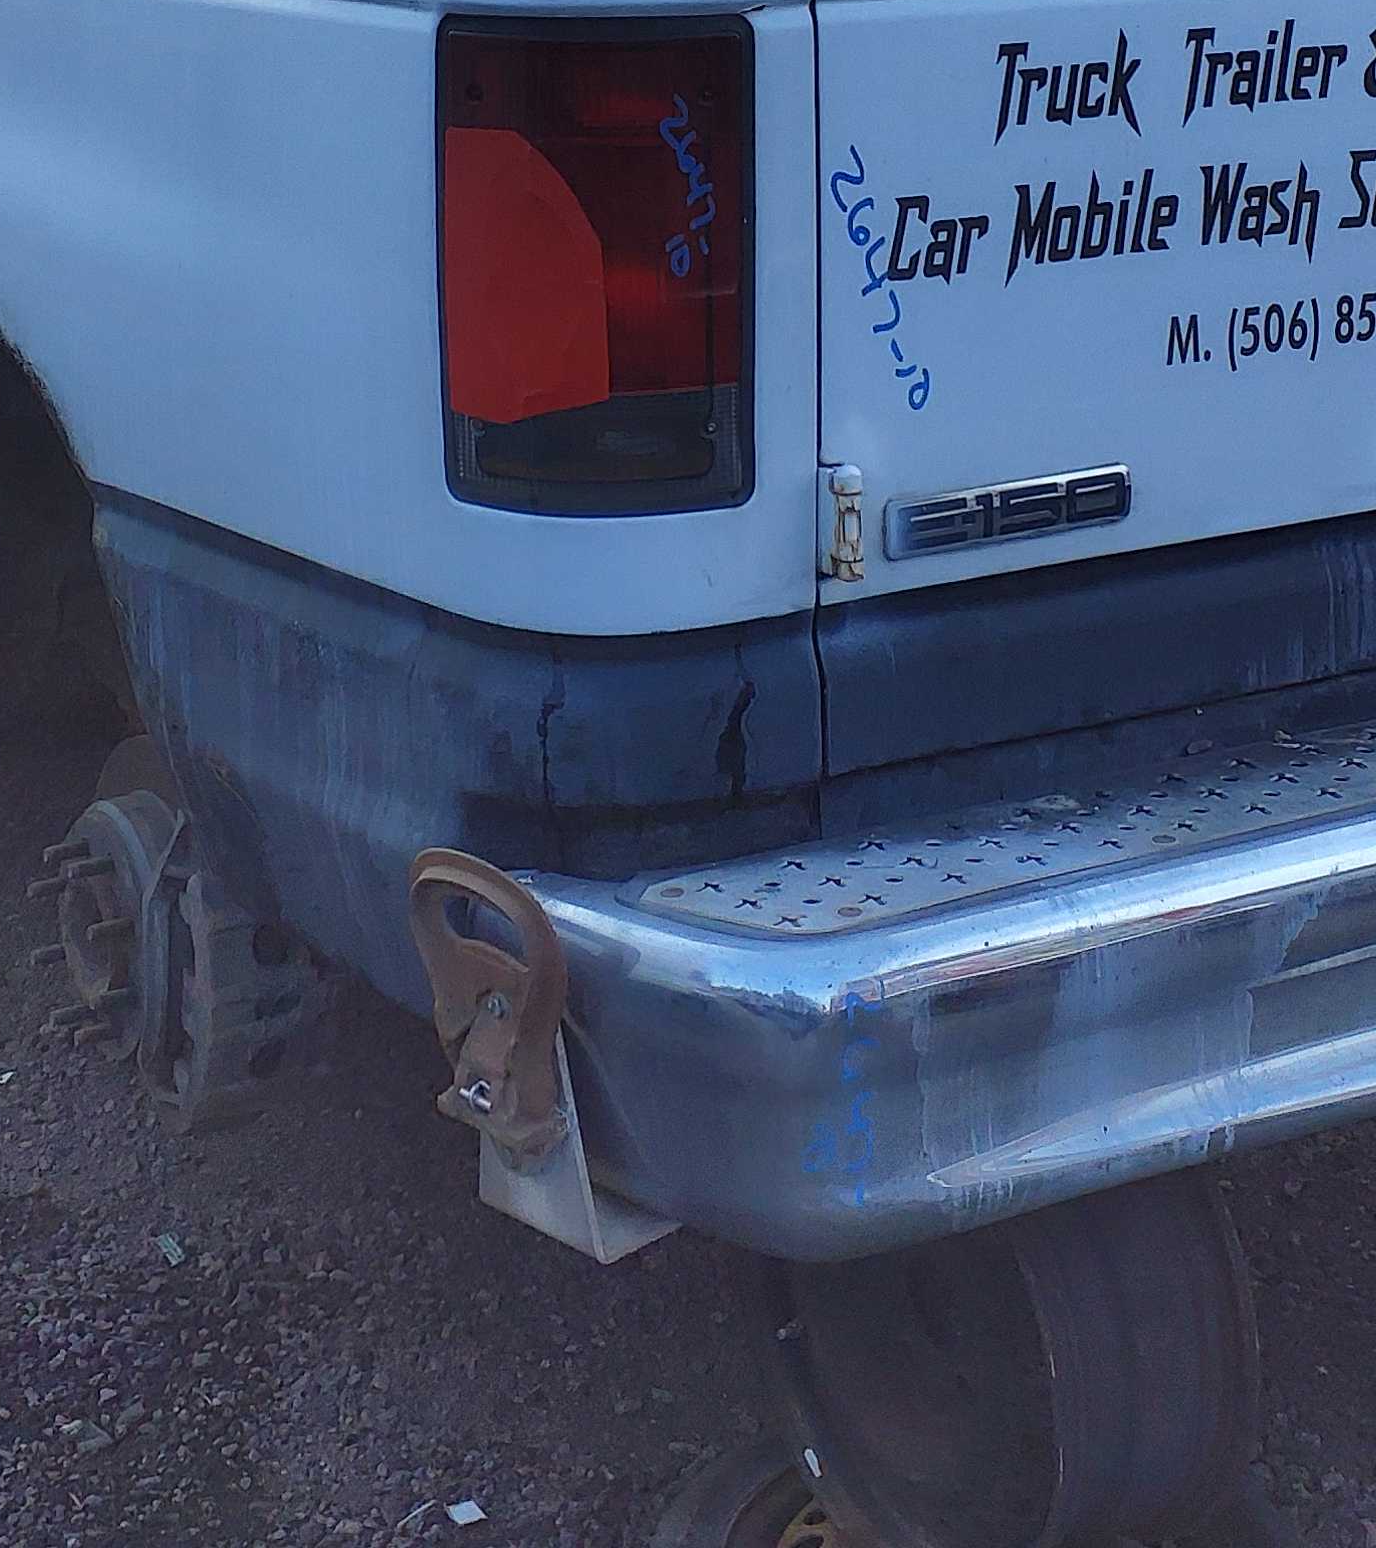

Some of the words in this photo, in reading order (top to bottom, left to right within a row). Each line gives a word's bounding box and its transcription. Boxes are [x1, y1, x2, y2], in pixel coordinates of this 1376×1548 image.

[994, 28, 1142, 146] Truck
[1181, 17, 1348, 130] Trailer
[886, 194, 991, 287] Car
[1004, 167, 1179, 289] Mobile
[1198, 159, 1322, 264] Wash
[1165, 314, 1212, 367] M.
[1226, 299, 1321, 372] (506)
